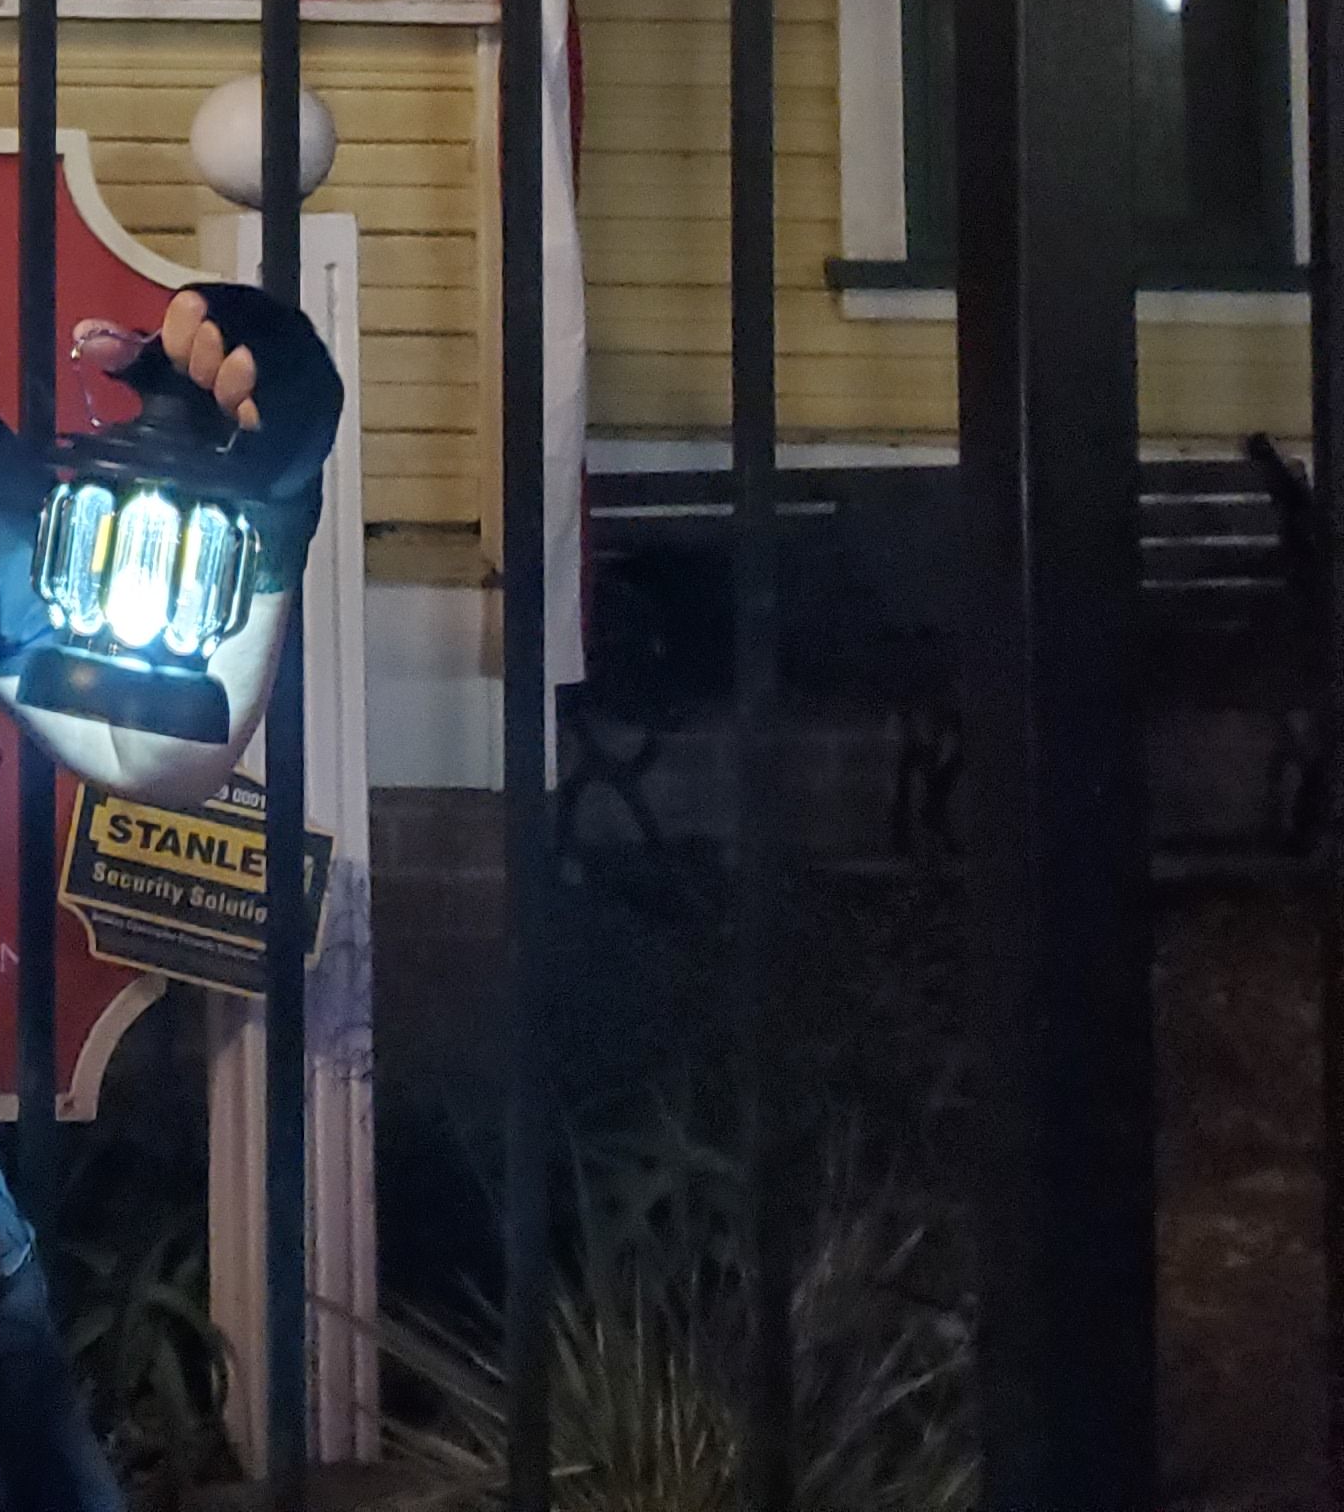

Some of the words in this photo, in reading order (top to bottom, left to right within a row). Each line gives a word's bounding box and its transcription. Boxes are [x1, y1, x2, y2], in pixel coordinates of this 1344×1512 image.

[107, 813, 267, 878] STANLE
[91, 861, 184, 906] Security
[189, 885, 268, 925] Solutio
